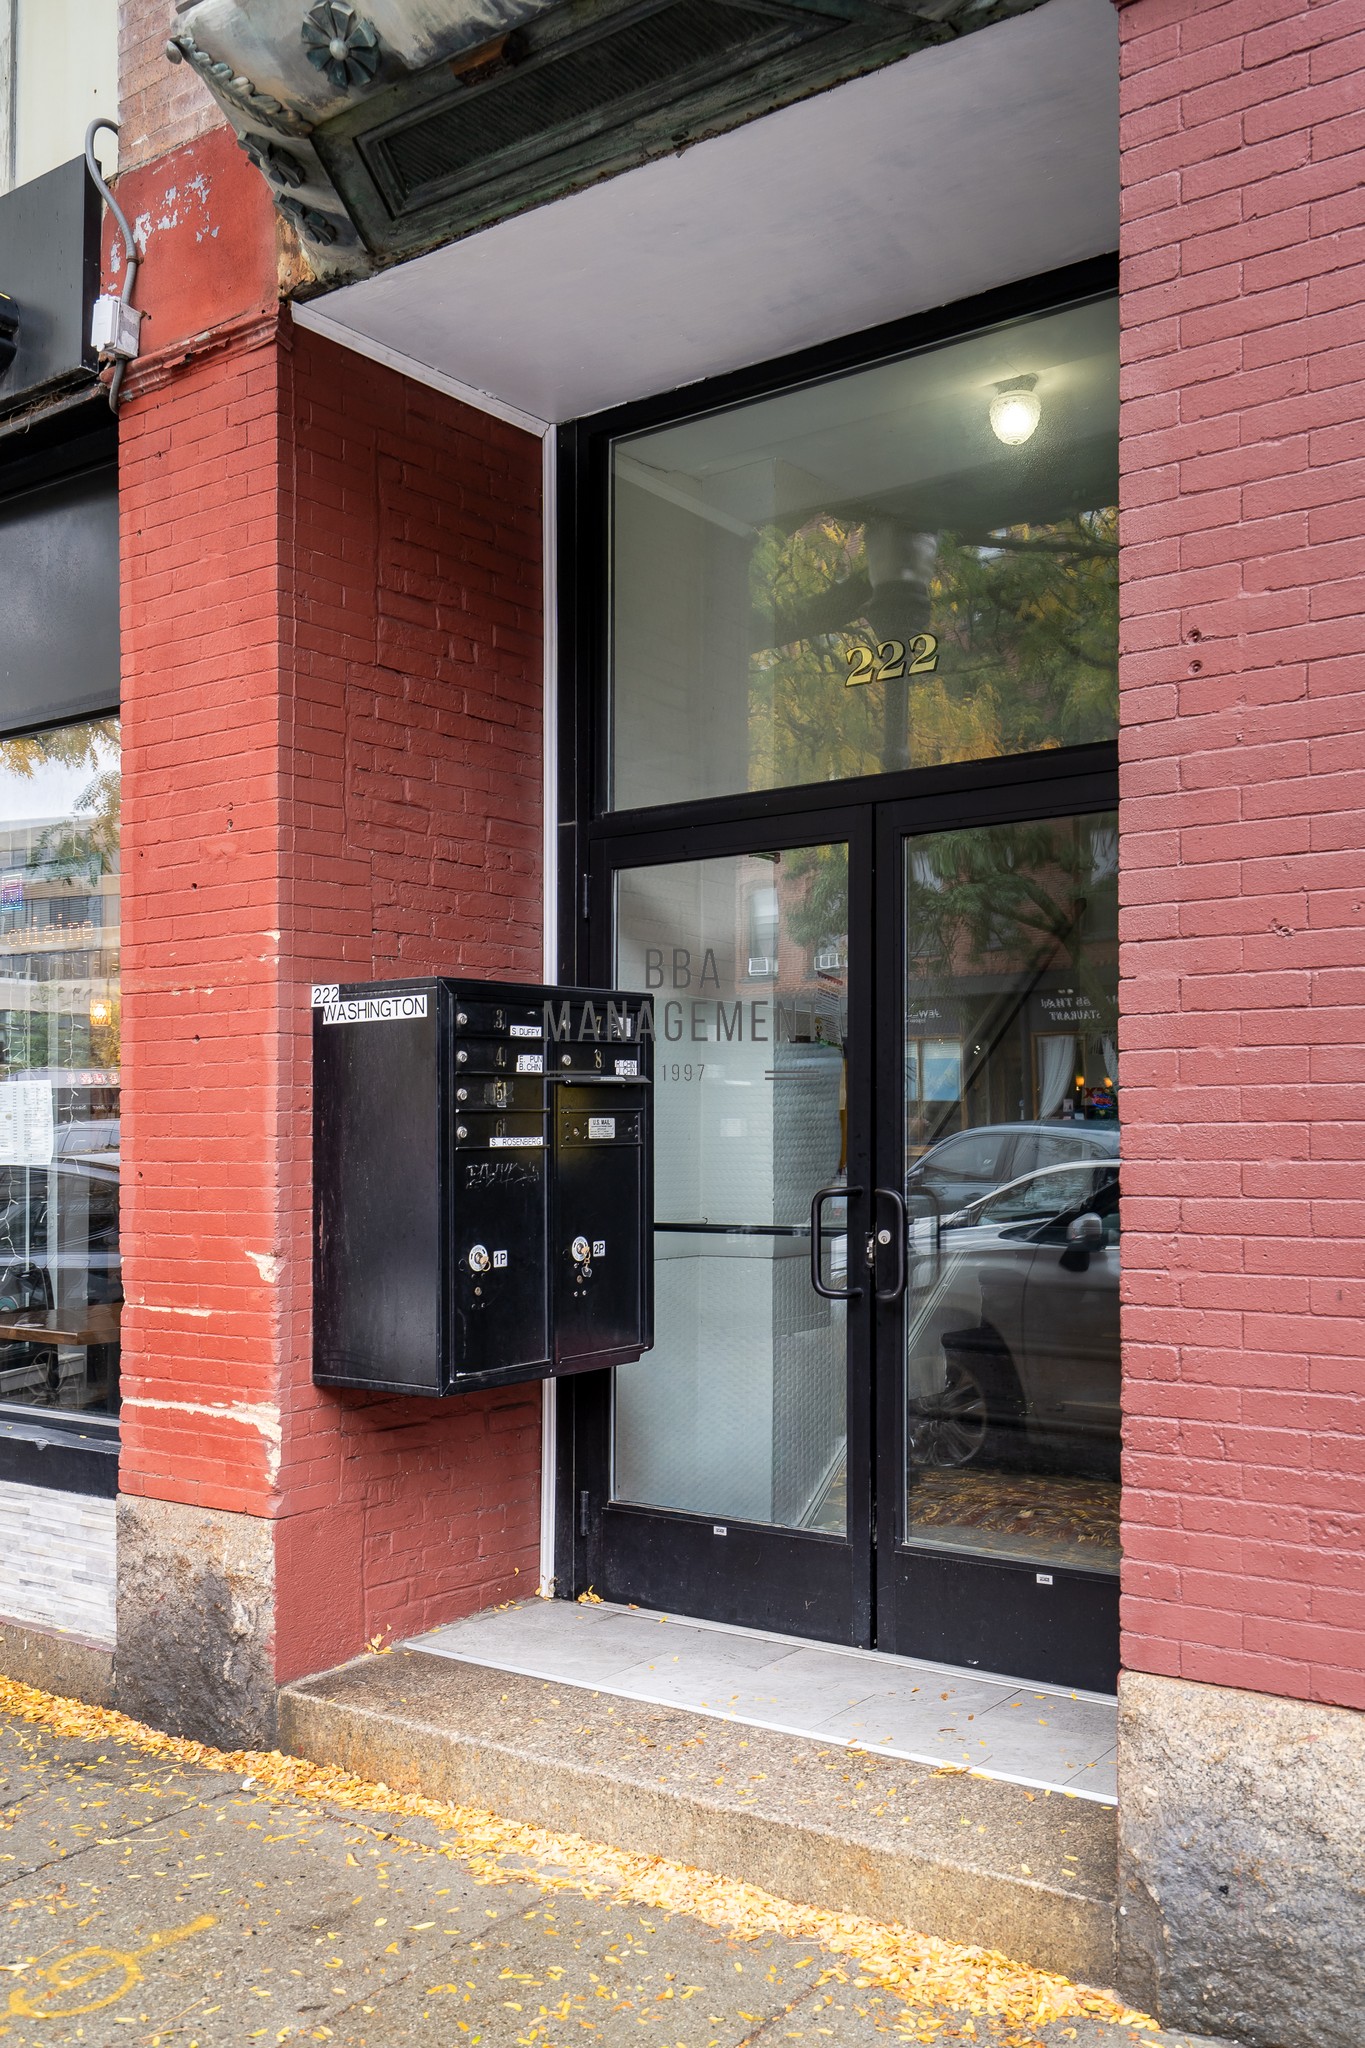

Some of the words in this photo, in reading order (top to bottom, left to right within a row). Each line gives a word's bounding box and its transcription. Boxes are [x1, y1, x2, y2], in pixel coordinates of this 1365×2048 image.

[845, 632, 939, 688] 222
[313, 987, 339, 1004] 222
[323, 997, 425, 1021] WASHINGTON
[519, 1028, 540, 1036] DUFFY
[595, 1050, 602, 1068] 8
[527, 1063, 541, 1071] CHIN
[502, 1137, 542, 1146] ROSENBERG
[593, 1243, 604, 1254] 2P
[494, 1253, 506, 1265] 1P
